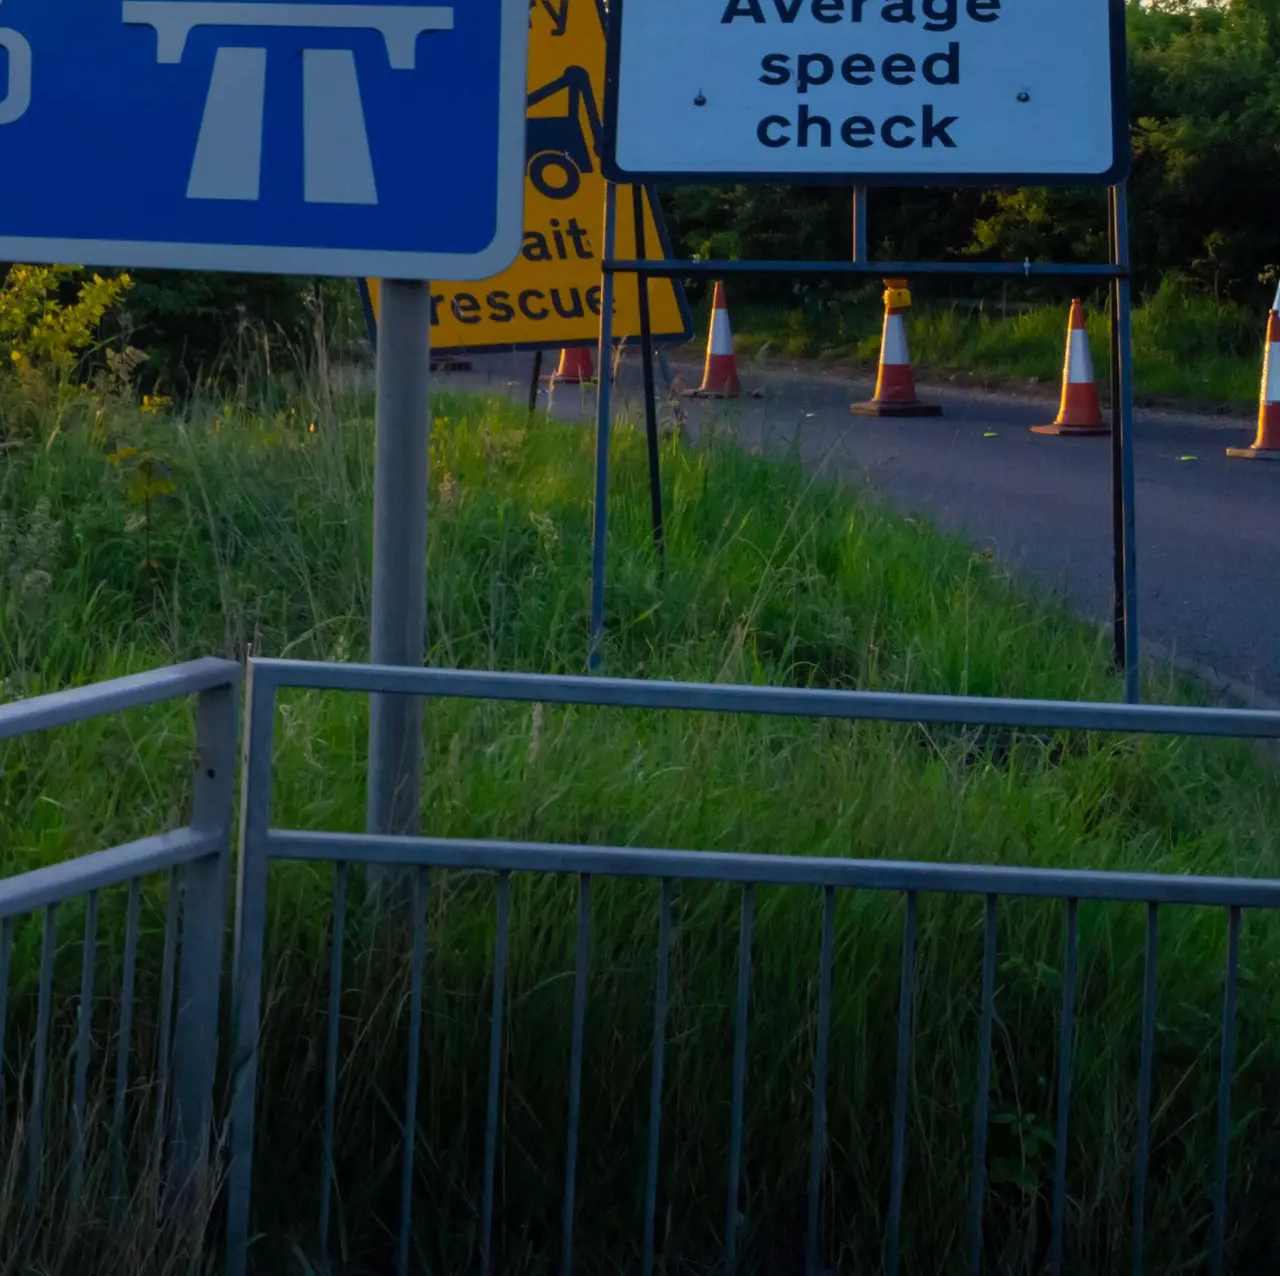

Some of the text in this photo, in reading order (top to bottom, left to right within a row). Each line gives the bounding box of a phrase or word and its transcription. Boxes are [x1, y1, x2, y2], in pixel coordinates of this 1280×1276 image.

[758, 42, 960, 94] speed
[756, 105, 959, 148] check
[522, 218, 594, 261] ait
[430, 285, 617, 326] rescue
